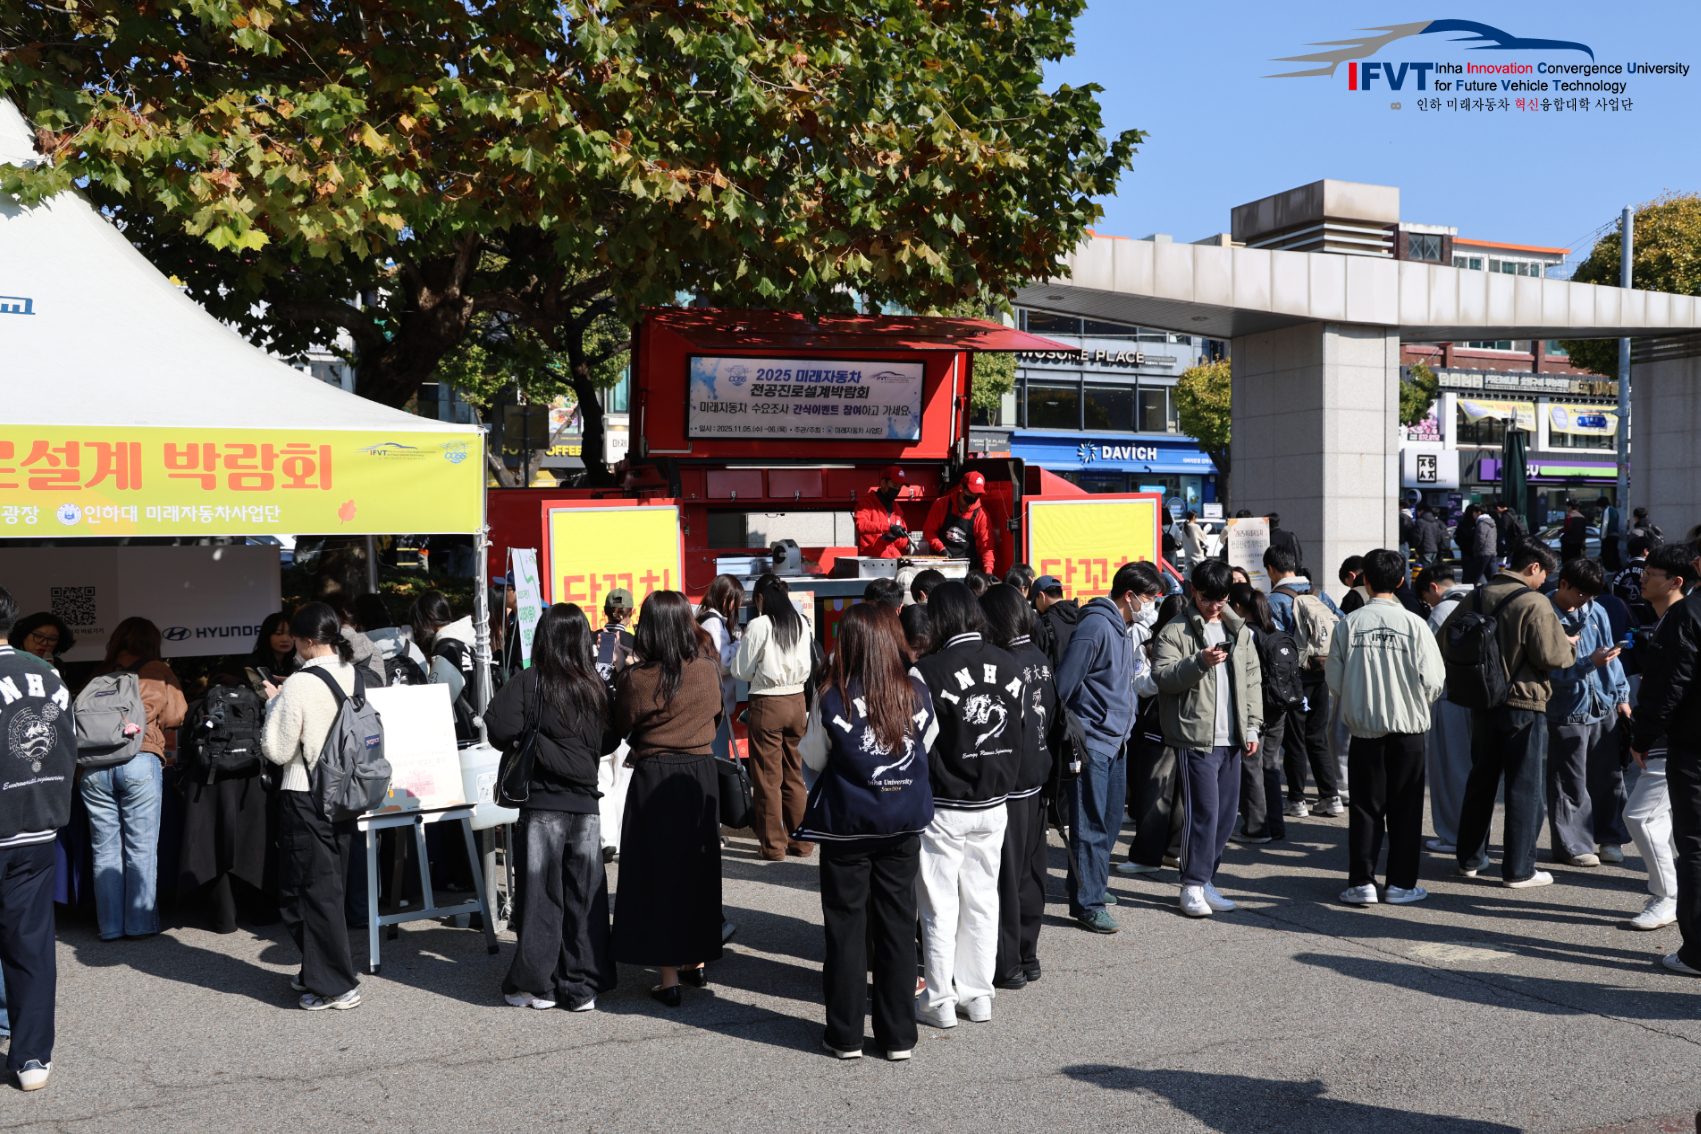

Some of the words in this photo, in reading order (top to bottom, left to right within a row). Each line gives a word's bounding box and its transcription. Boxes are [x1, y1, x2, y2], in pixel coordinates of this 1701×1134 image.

[1096, 350, 1144, 363] PLACE
[756, 369, 792, 382] 2025
[796, 370, 862, 384] 미래자동차
[750, 384, 870, 399] 전공진로설계박람회
[700, 402, 747, 414] 미래자동차
[751, 403, 789, 415] 수요조사
[793, 404, 839, 416] 간식이벤트
[882, 405, 910, 416] 가세요
[545, 445, 582, 456] OFFEE
[1102, 443, 1157, 461] DAVICH
[163, 442, 333, 492] 박람회
[1, 505, 40, 525] 광장
[84, 505, 138, 523] 인하대
[146, 504, 282, 522] 미래자동차사업단
[196, 625, 263, 639] HYUNDA
[940, 663, 1023, 705] INHA
[0, 672, 70, 713] NHA
[832, 693, 930, 733] INA
[884, 778, 914, 786] University
